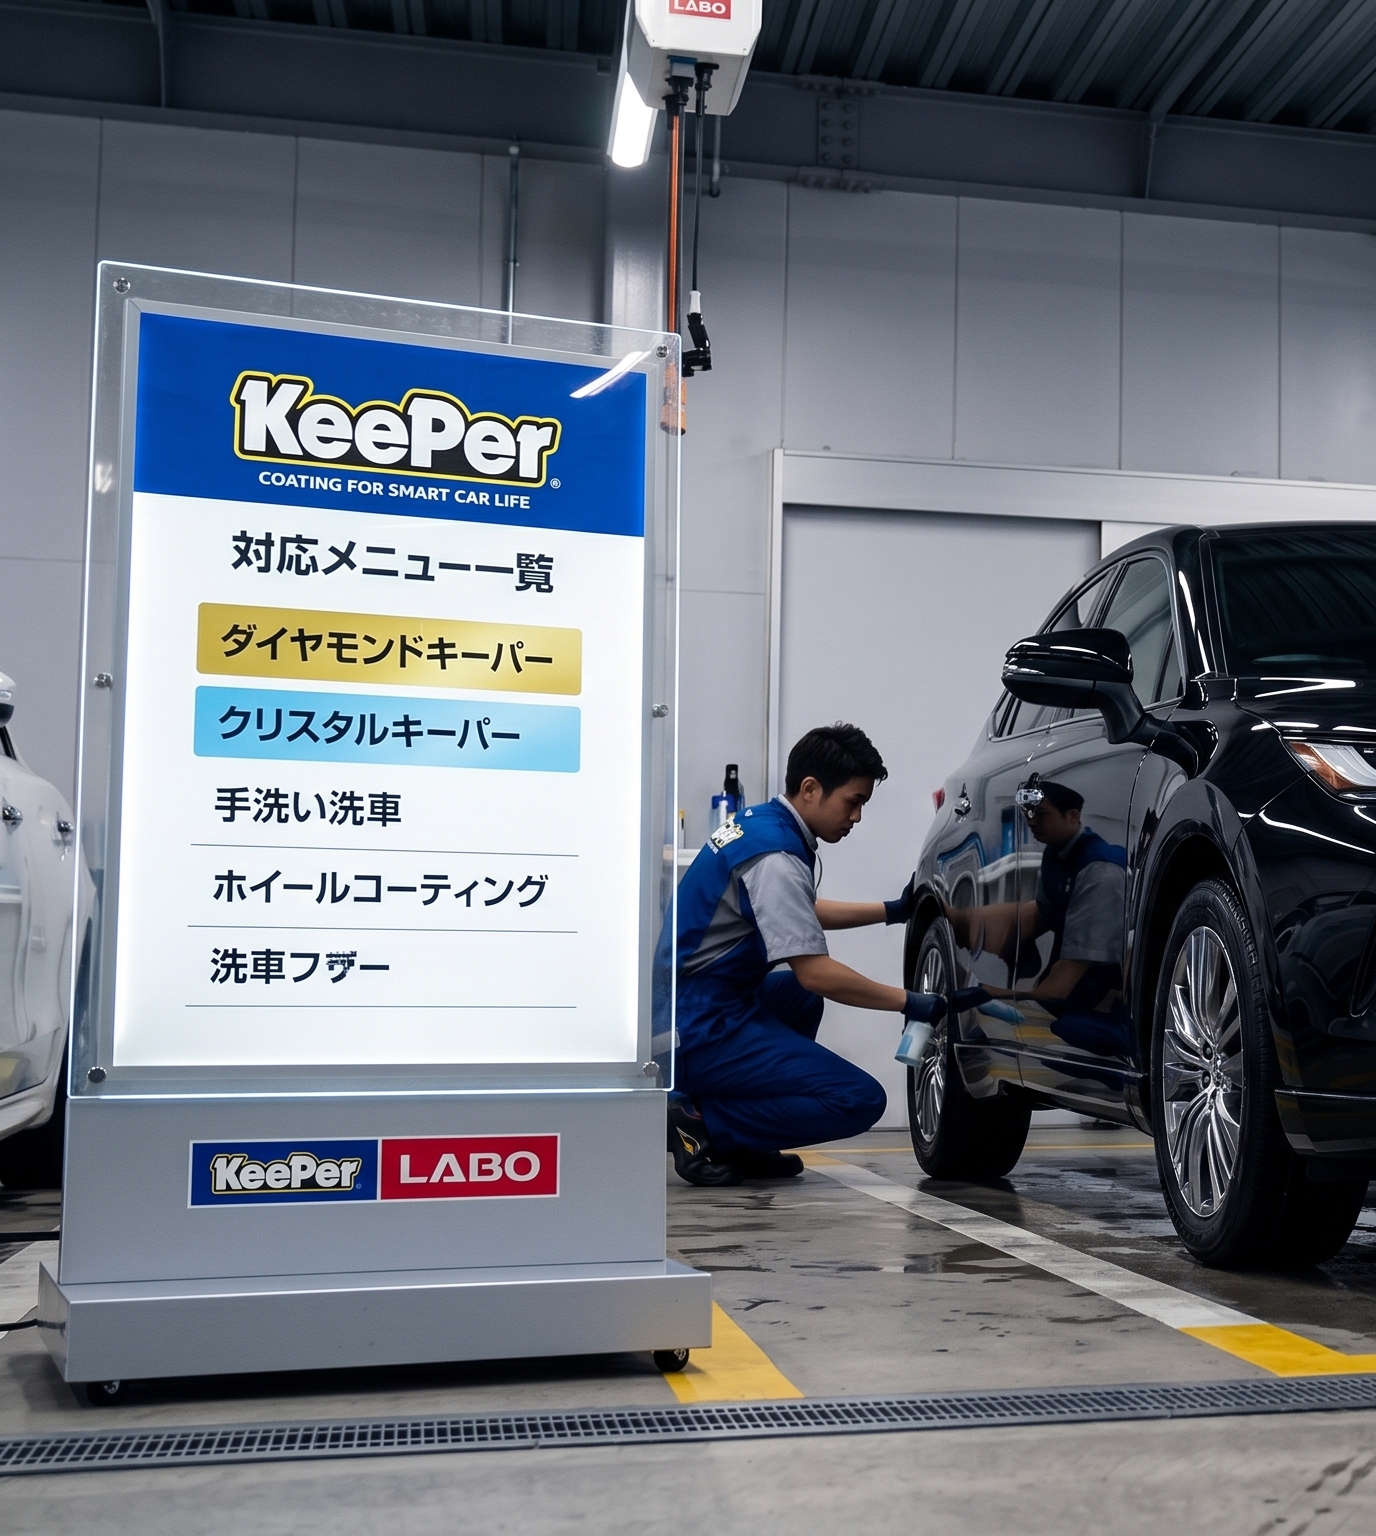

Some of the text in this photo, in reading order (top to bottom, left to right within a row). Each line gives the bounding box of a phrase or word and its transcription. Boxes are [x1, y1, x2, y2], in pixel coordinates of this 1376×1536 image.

[674, 0, 726, 14] LABO
[234, 375, 557, 481] KeePer
[258, 471, 530, 509] COATING FOR SMART CAR LIFE
[231, 530, 554, 593] 対応メニュー一覧
[220, 624, 553, 674] ダイヤモンドキーパー
[218, 705, 520, 750] クリスタルキーパー
[214, 787, 402, 827] 手洗い洗車
[213, 870, 549, 908] ホイールコーティング
[212, 1151, 541, 1192] KeePer LABO
